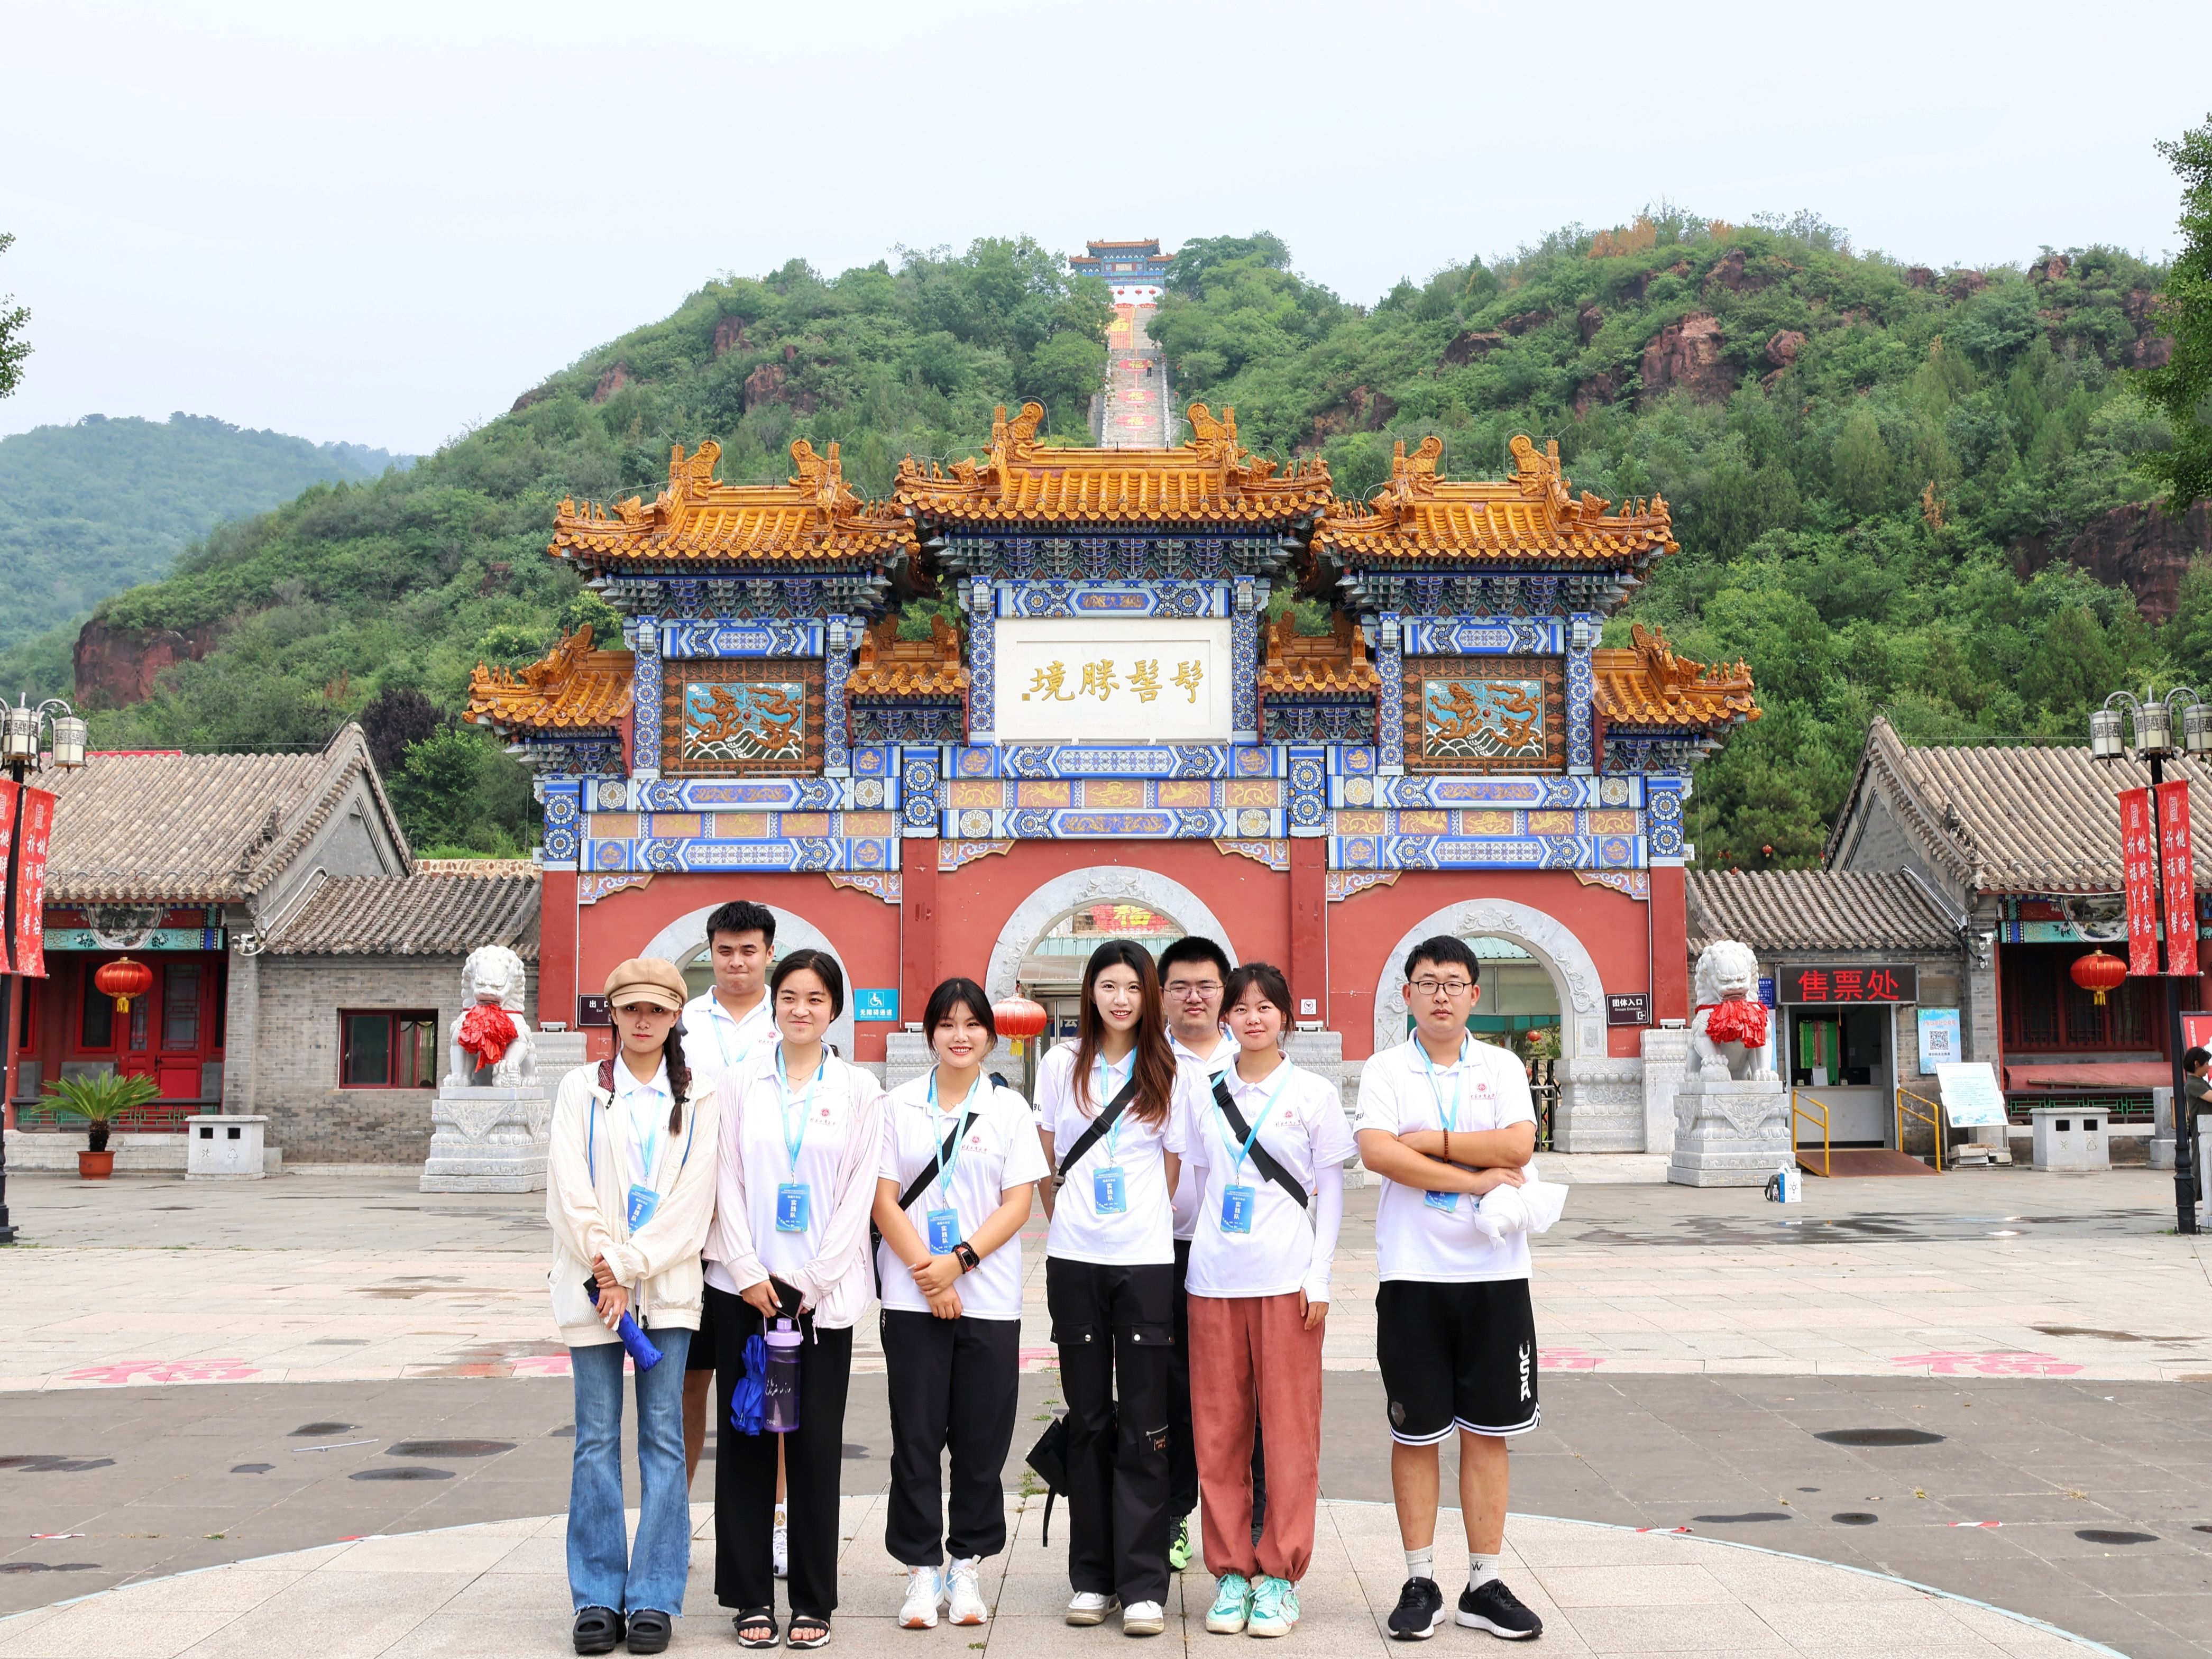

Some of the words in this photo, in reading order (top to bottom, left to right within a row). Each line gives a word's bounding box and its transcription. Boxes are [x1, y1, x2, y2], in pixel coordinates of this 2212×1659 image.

[1113, 904, 1151, 927] 福
[1798, 969, 1899, 1002] 售票处
[1612, 998, 1642, 1007] 团体入口
[1519, 1340, 1531, 1402] USA
